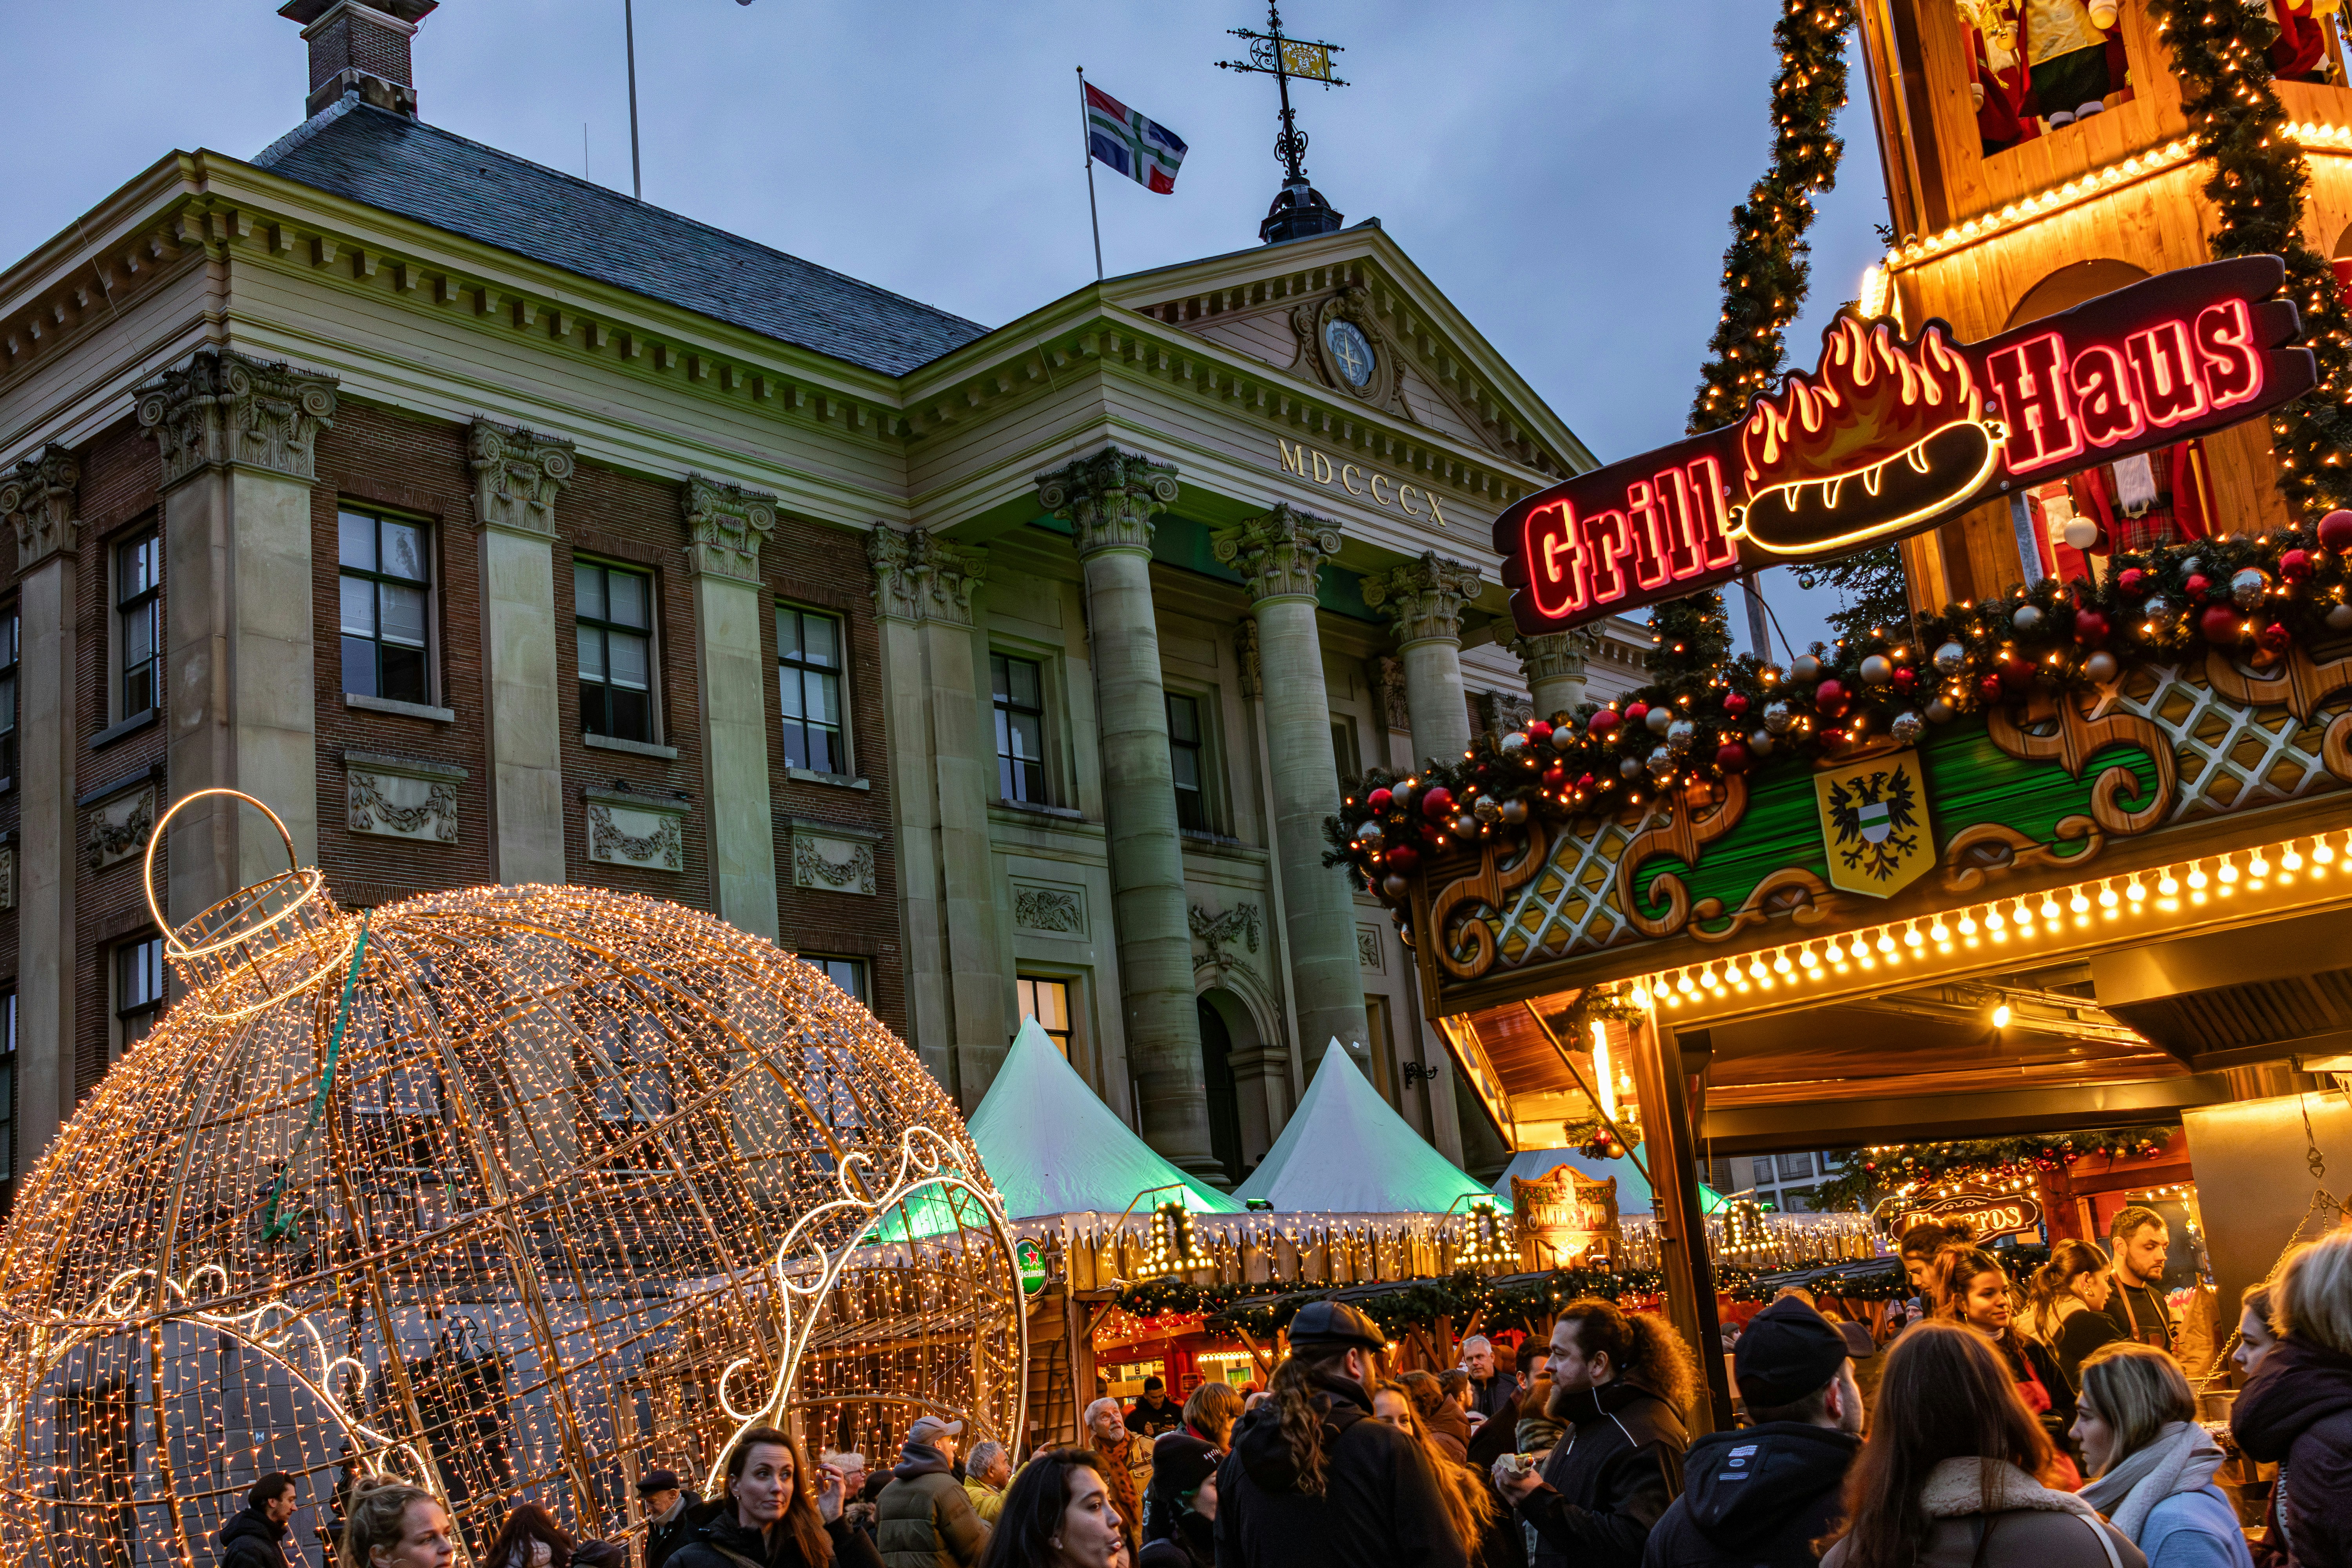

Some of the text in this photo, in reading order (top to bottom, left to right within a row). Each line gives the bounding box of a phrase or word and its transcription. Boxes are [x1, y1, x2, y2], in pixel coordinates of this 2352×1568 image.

[1277, 439, 1446, 526] MDCCCX
[1524, 298, 2263, 619] Grill Haus
